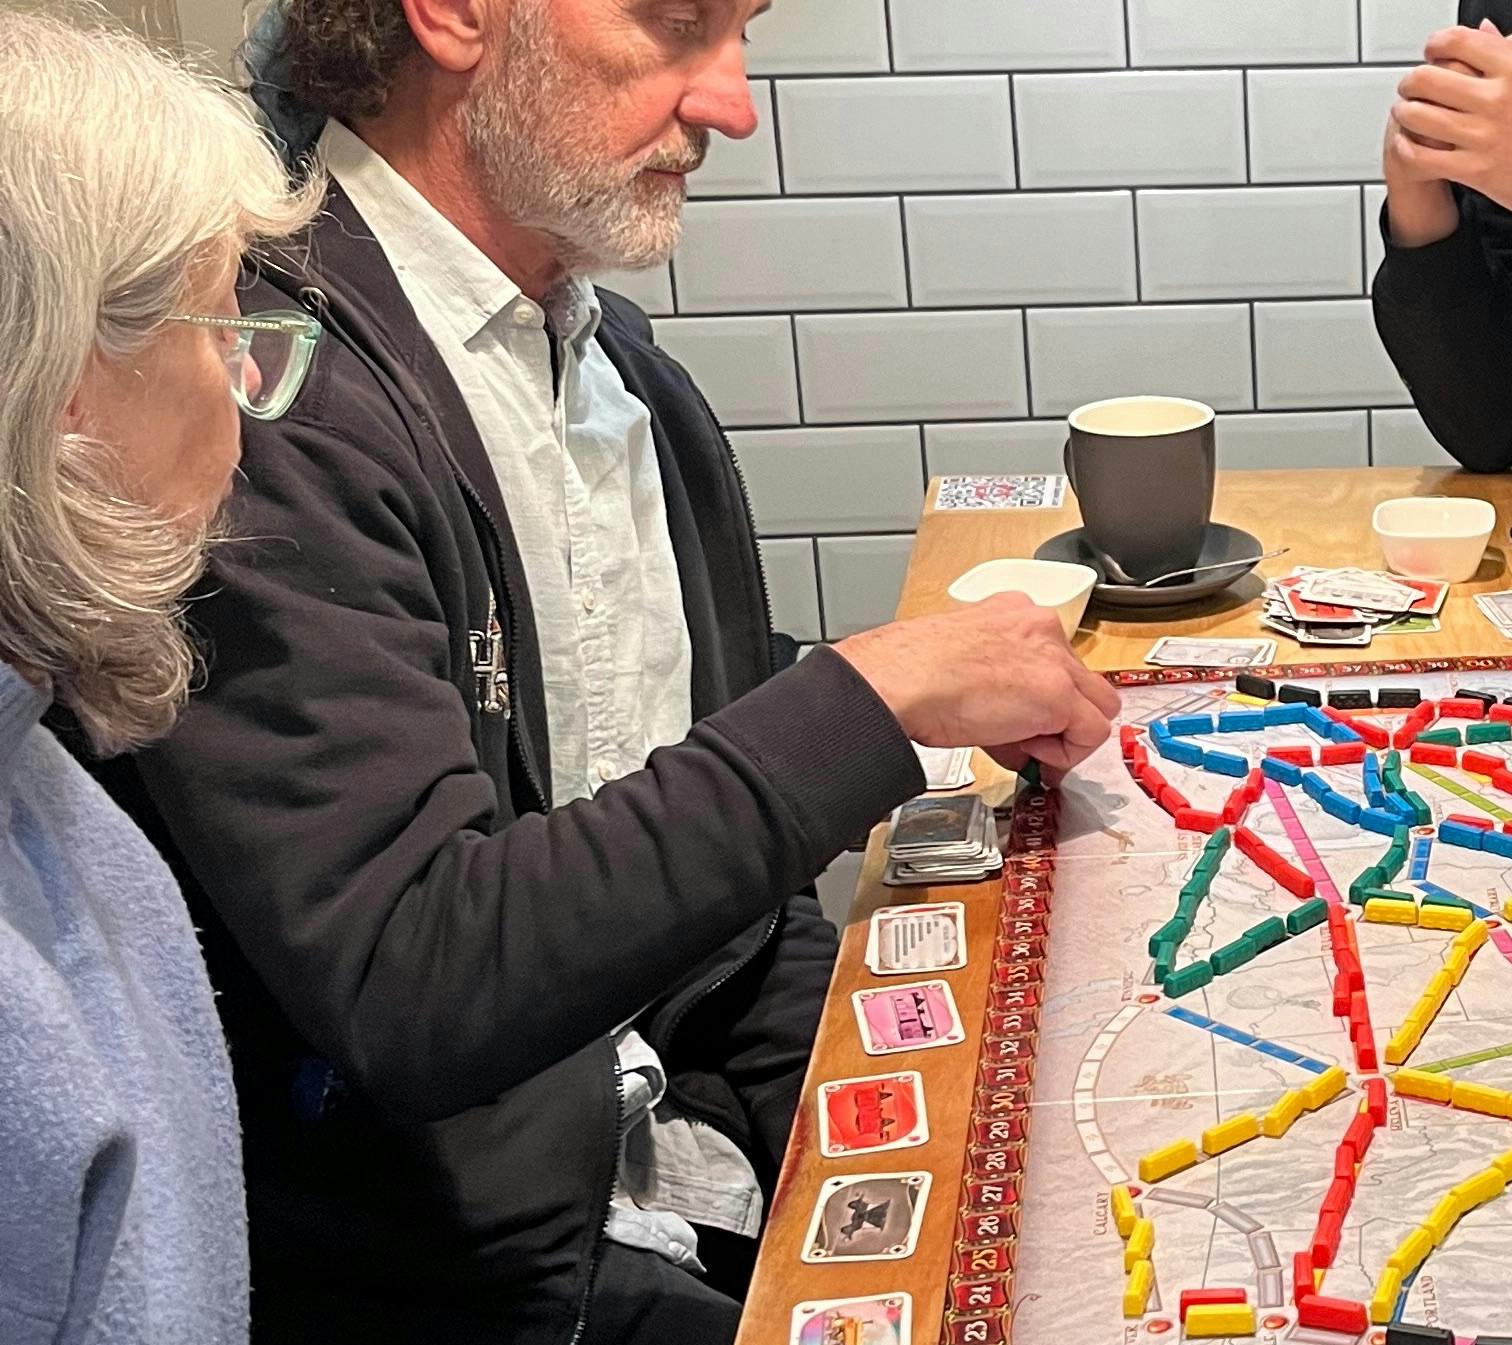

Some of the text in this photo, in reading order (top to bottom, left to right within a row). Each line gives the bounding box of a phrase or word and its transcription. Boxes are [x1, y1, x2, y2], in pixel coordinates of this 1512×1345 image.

[1022, 856, 1041, 869] 40
[1020, 877, 1038, 890] 39
[1015, 921, 1034, 934] 37
[1012, 942, 1030, 957] 36
[1007, 965, 1029, 982] 35
[1002, 1015, 1021, 1030] 33
[1000, 1040, 1019, 1056] 32
[996, 1068, 1016, 1081] 31
[991, 1092, 1015, 1110] 30
[988, 1121, 1010, 1139] 29
[985, 1151, 1007, 1170] 28
[981, 1185, 1003, 1203] 27
[1095, 1191, 1109, 1236] CALGARY
[977, 1215, 1000, 1235] 26
[971, 1248, 998, 1270] 25
[968, 1285, 992, 1305] 24
[1421, 1274, 1439, 1329] PORTLAND
[964, 1320, 988, 1341] 23
